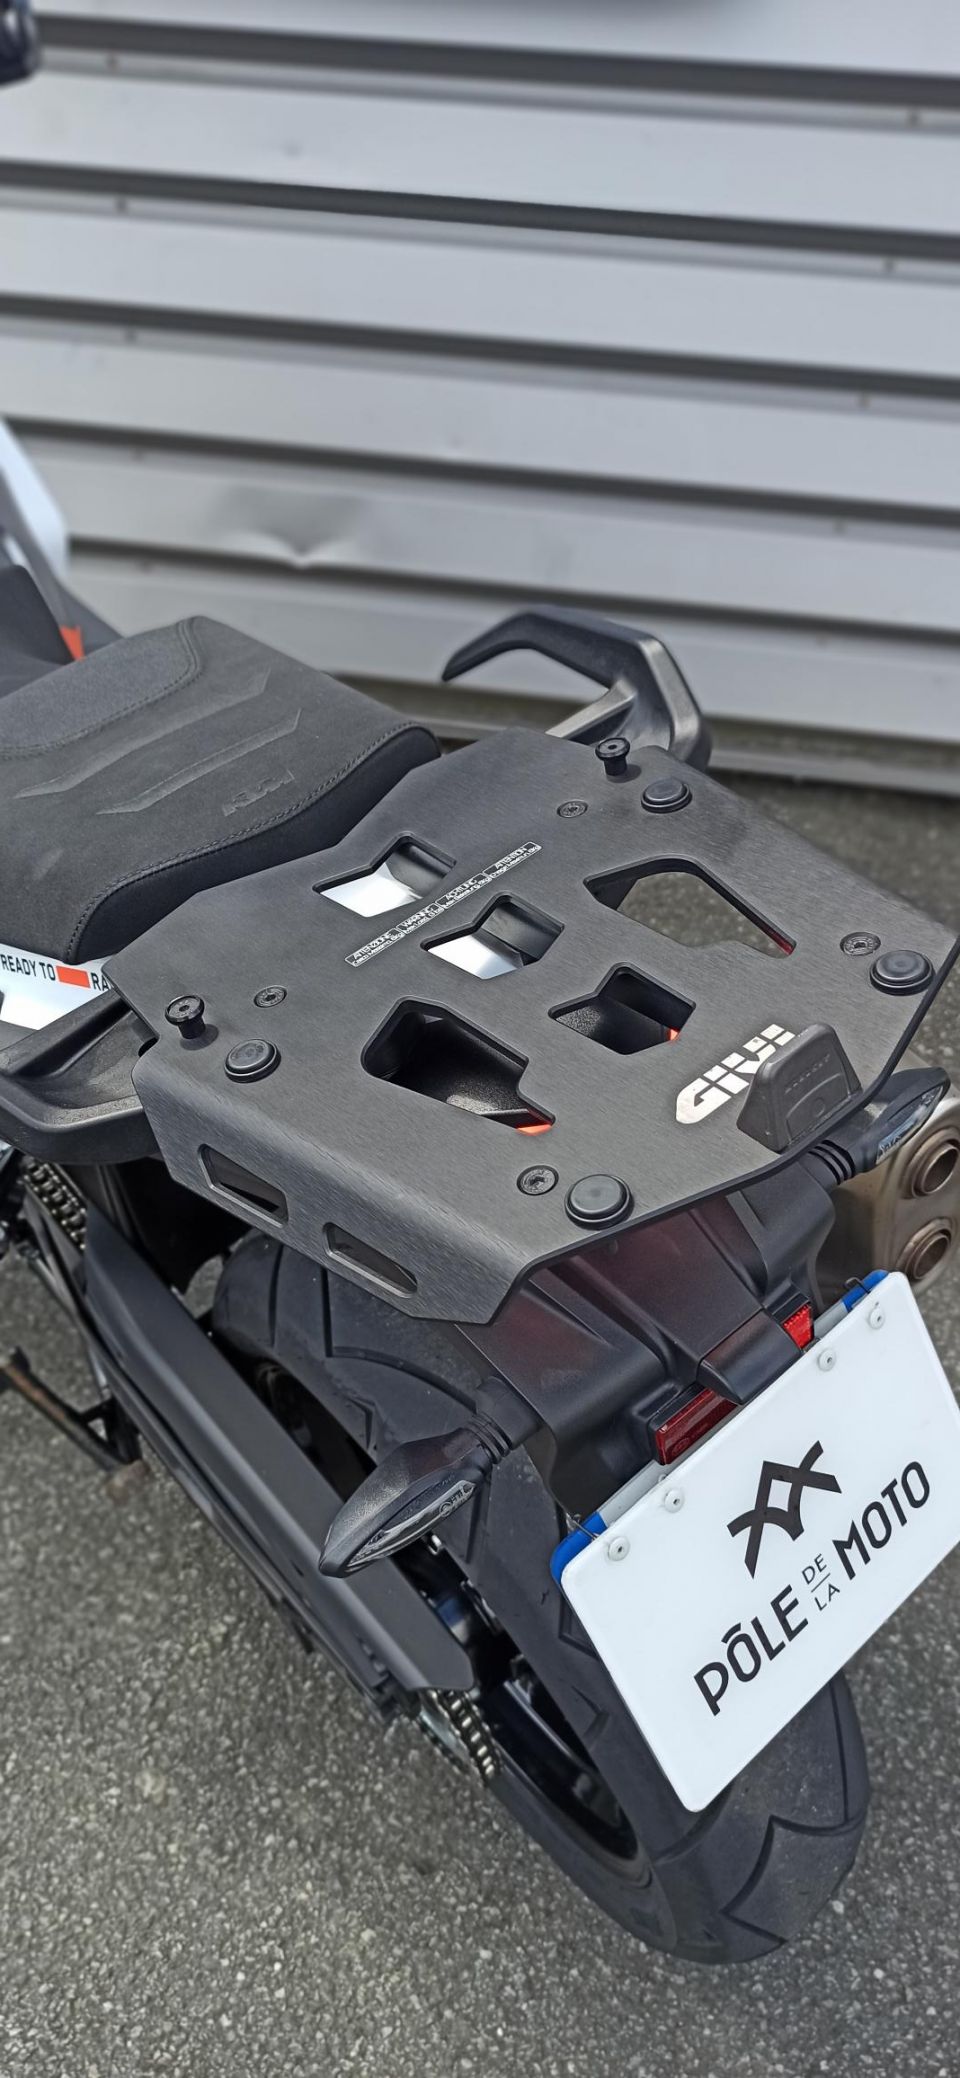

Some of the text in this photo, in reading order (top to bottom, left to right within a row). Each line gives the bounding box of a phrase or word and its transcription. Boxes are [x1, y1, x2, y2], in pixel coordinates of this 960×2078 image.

[0, 954, 36, 977] READY
[39, 962, 56, 981] TO
[693, 1461, 930, 1717] PÔLE DE LA MOTO
